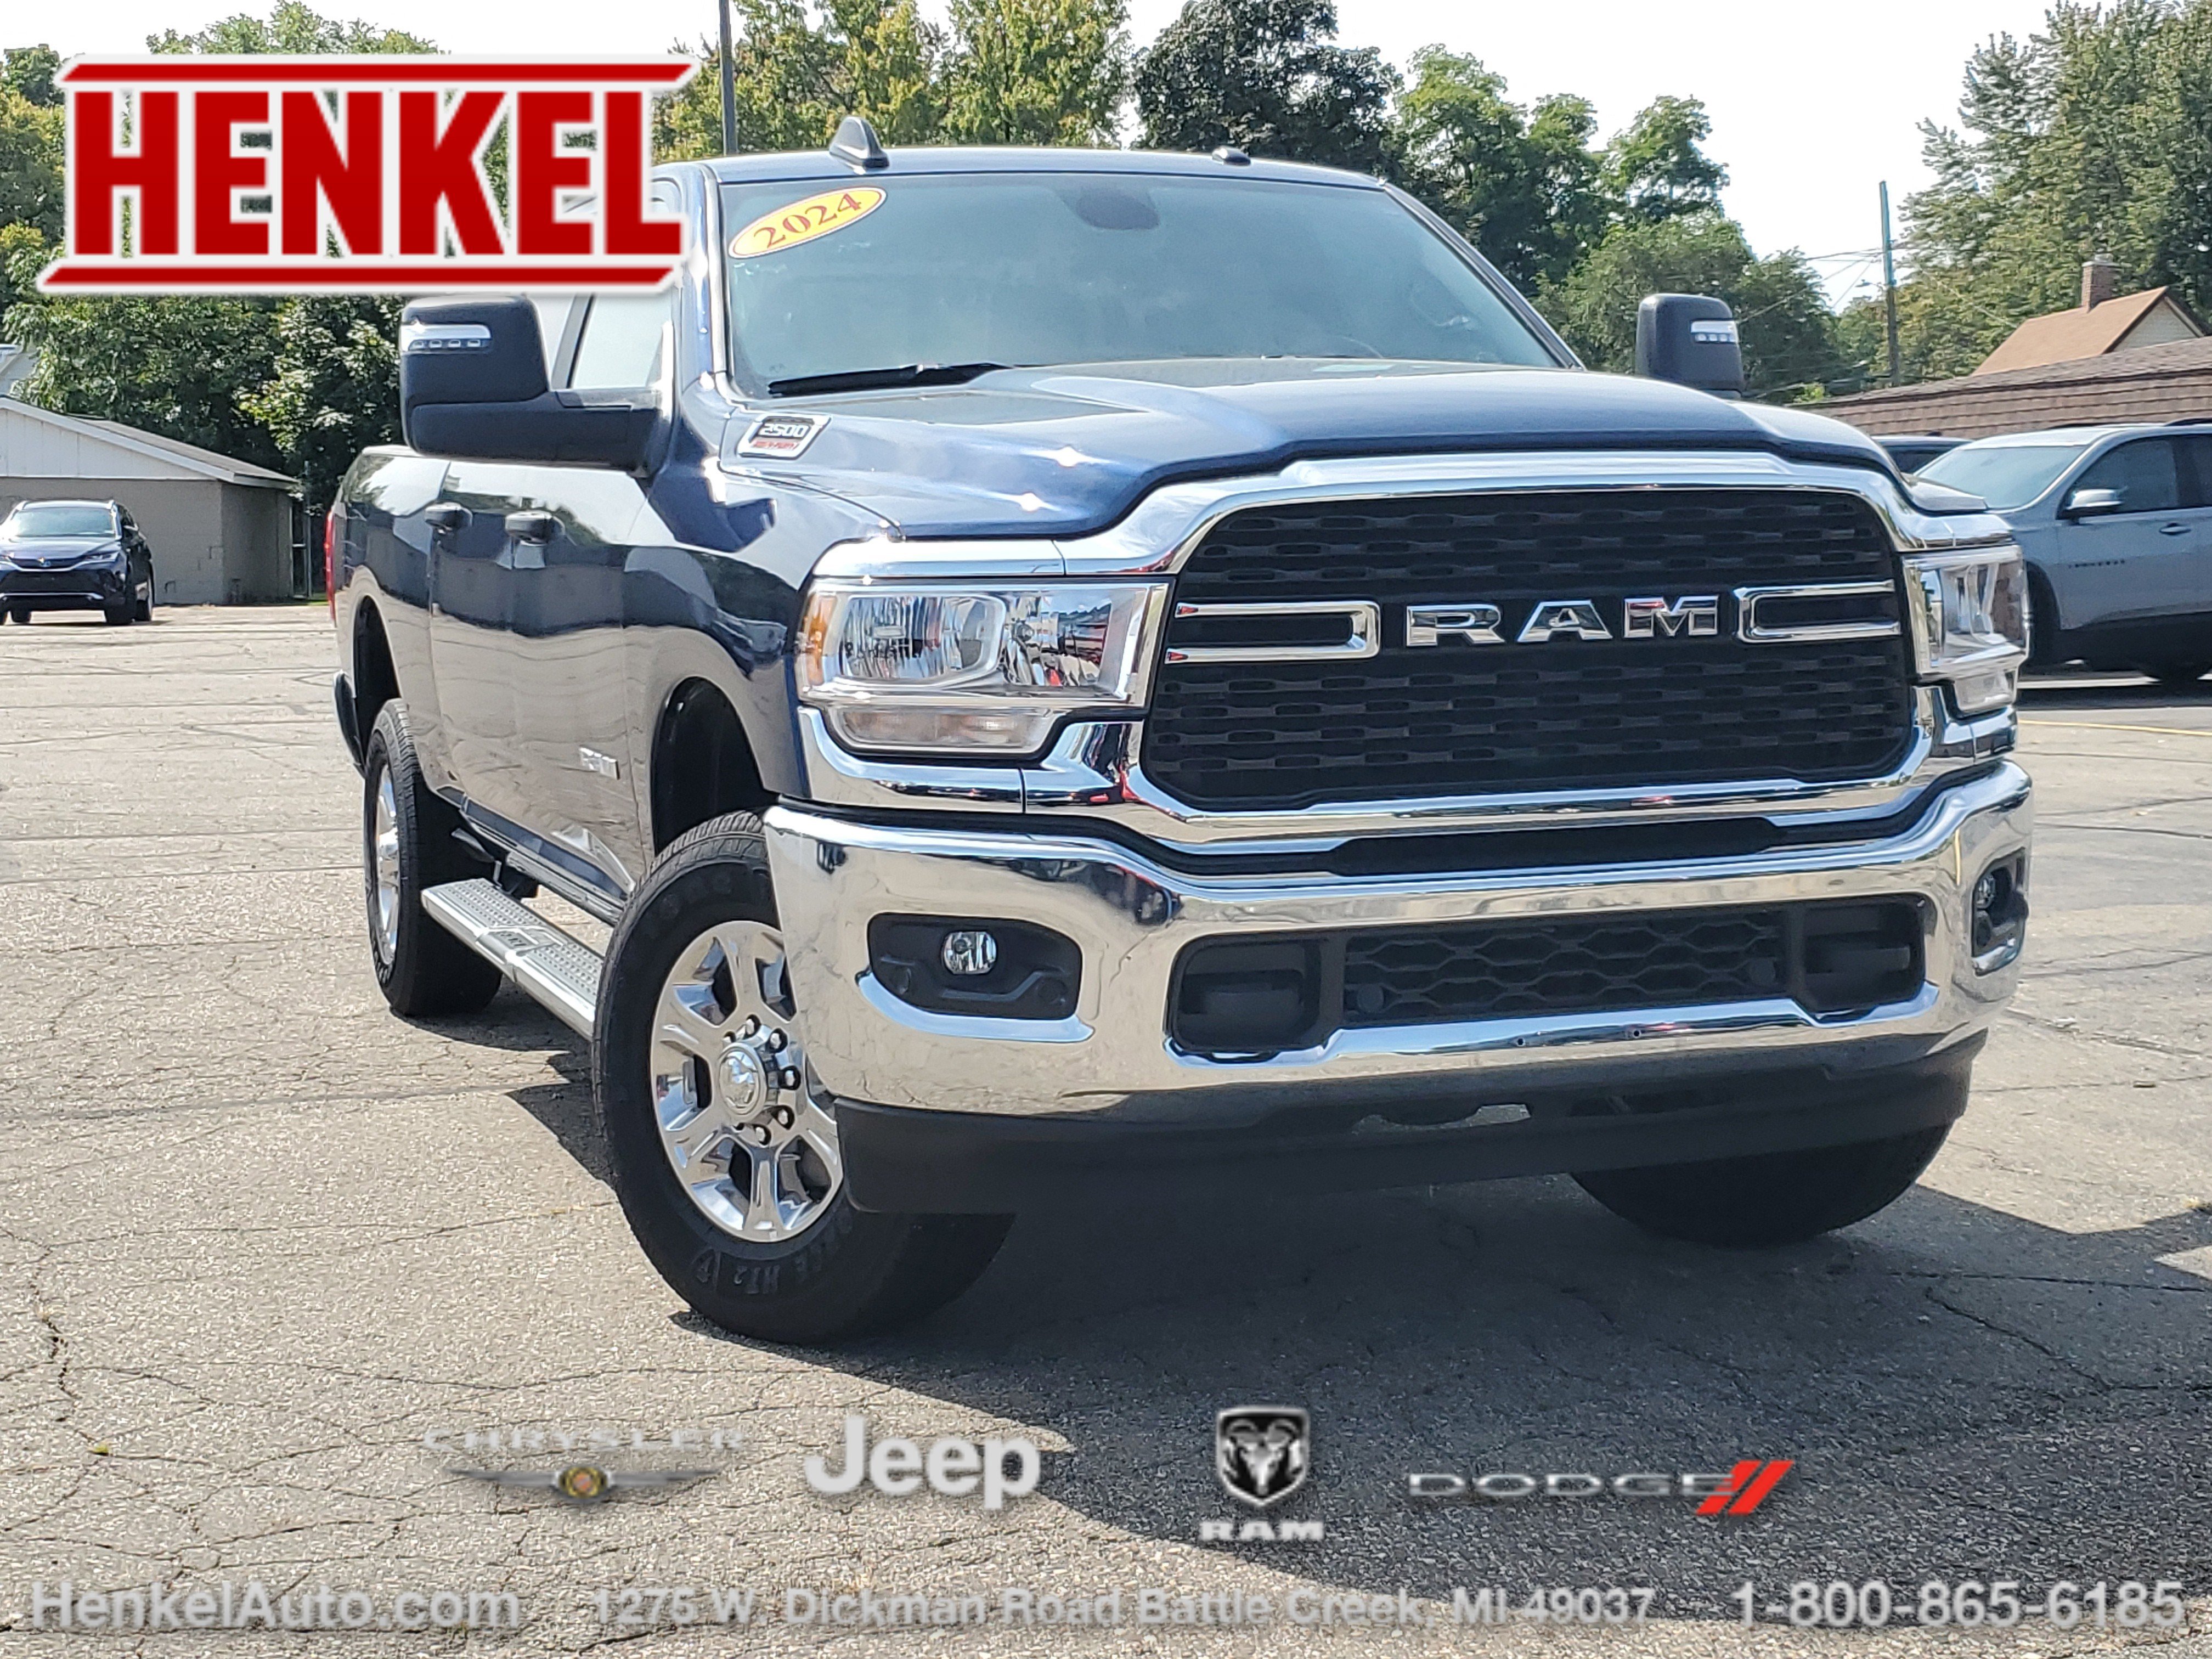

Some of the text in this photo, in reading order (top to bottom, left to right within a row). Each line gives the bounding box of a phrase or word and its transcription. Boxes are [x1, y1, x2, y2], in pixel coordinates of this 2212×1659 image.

[753, 193, 862, 249] 2024
[759, 423, 810, 438] 2500
[1406, 595, 1719, 647] RAM
